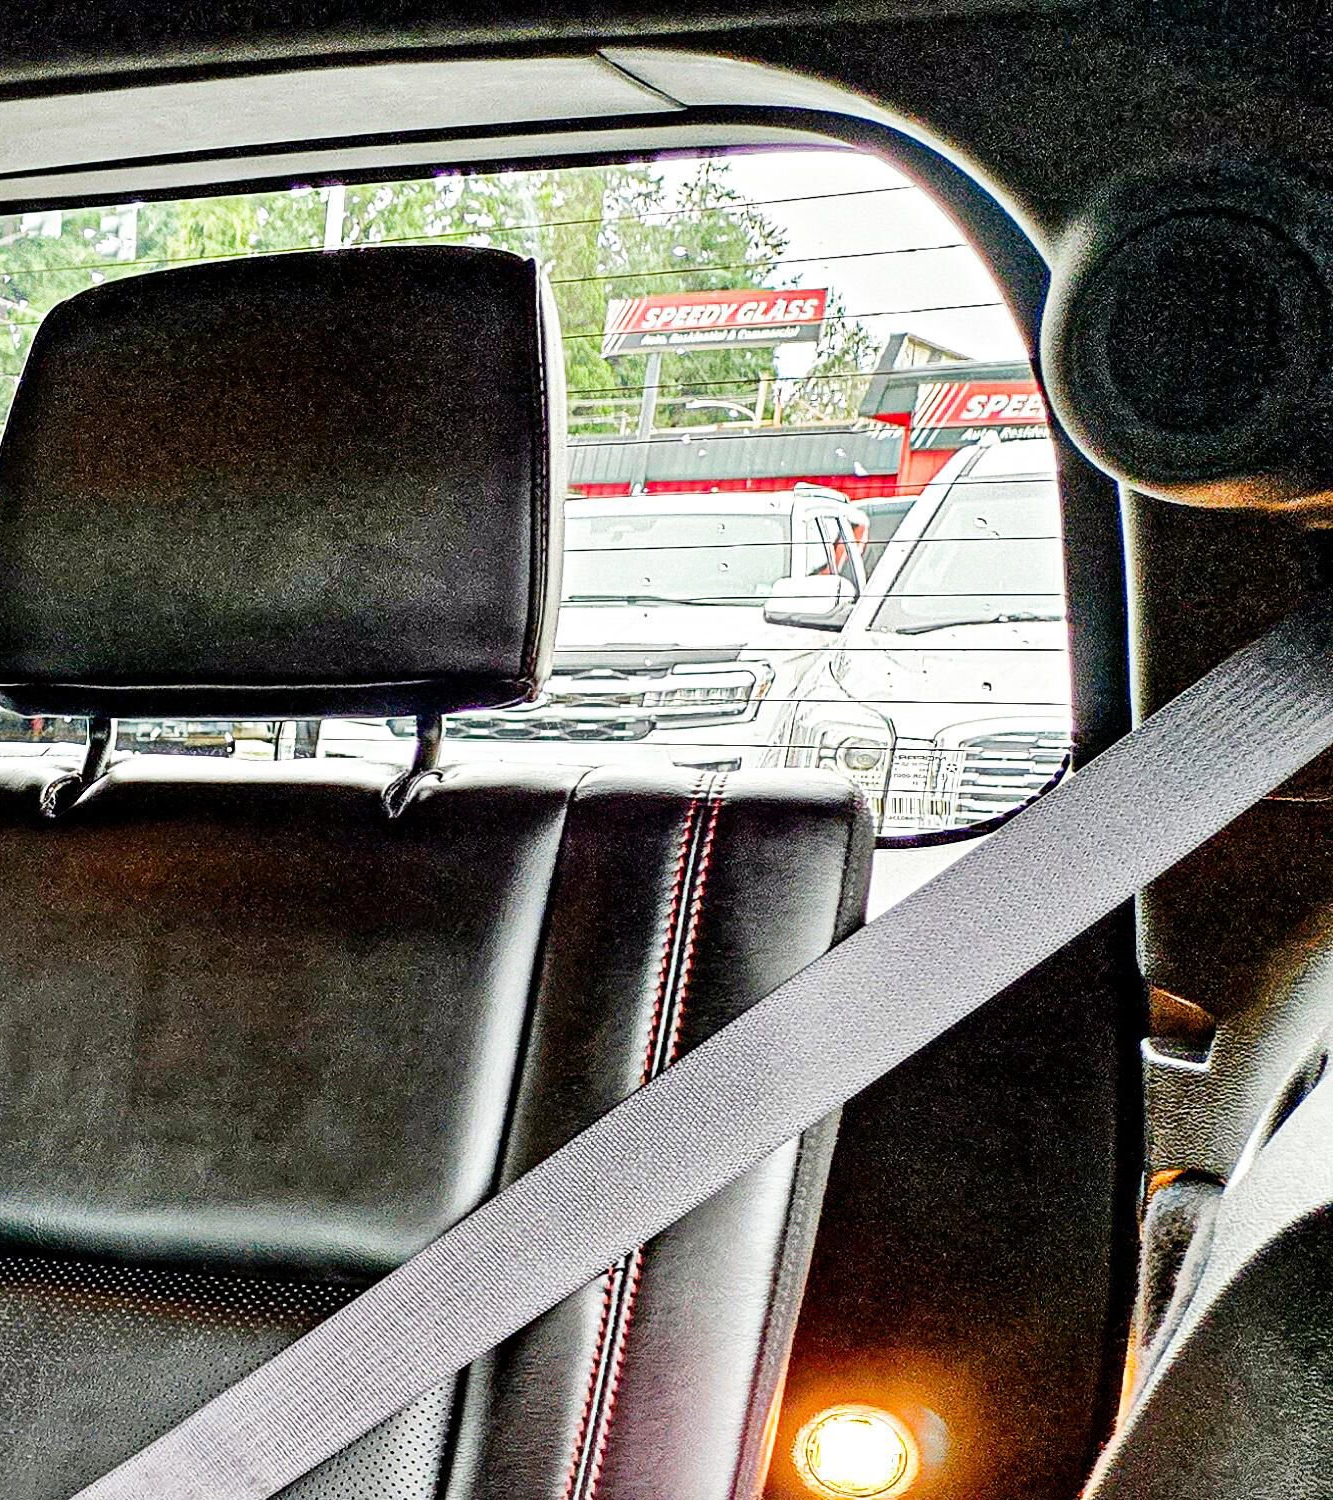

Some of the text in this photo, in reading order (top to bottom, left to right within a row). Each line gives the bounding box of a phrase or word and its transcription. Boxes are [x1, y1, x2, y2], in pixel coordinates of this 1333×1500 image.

[641, 298, 819, 329] SPEEDY GLASS
[738, 327, 800, 340] Commercial
